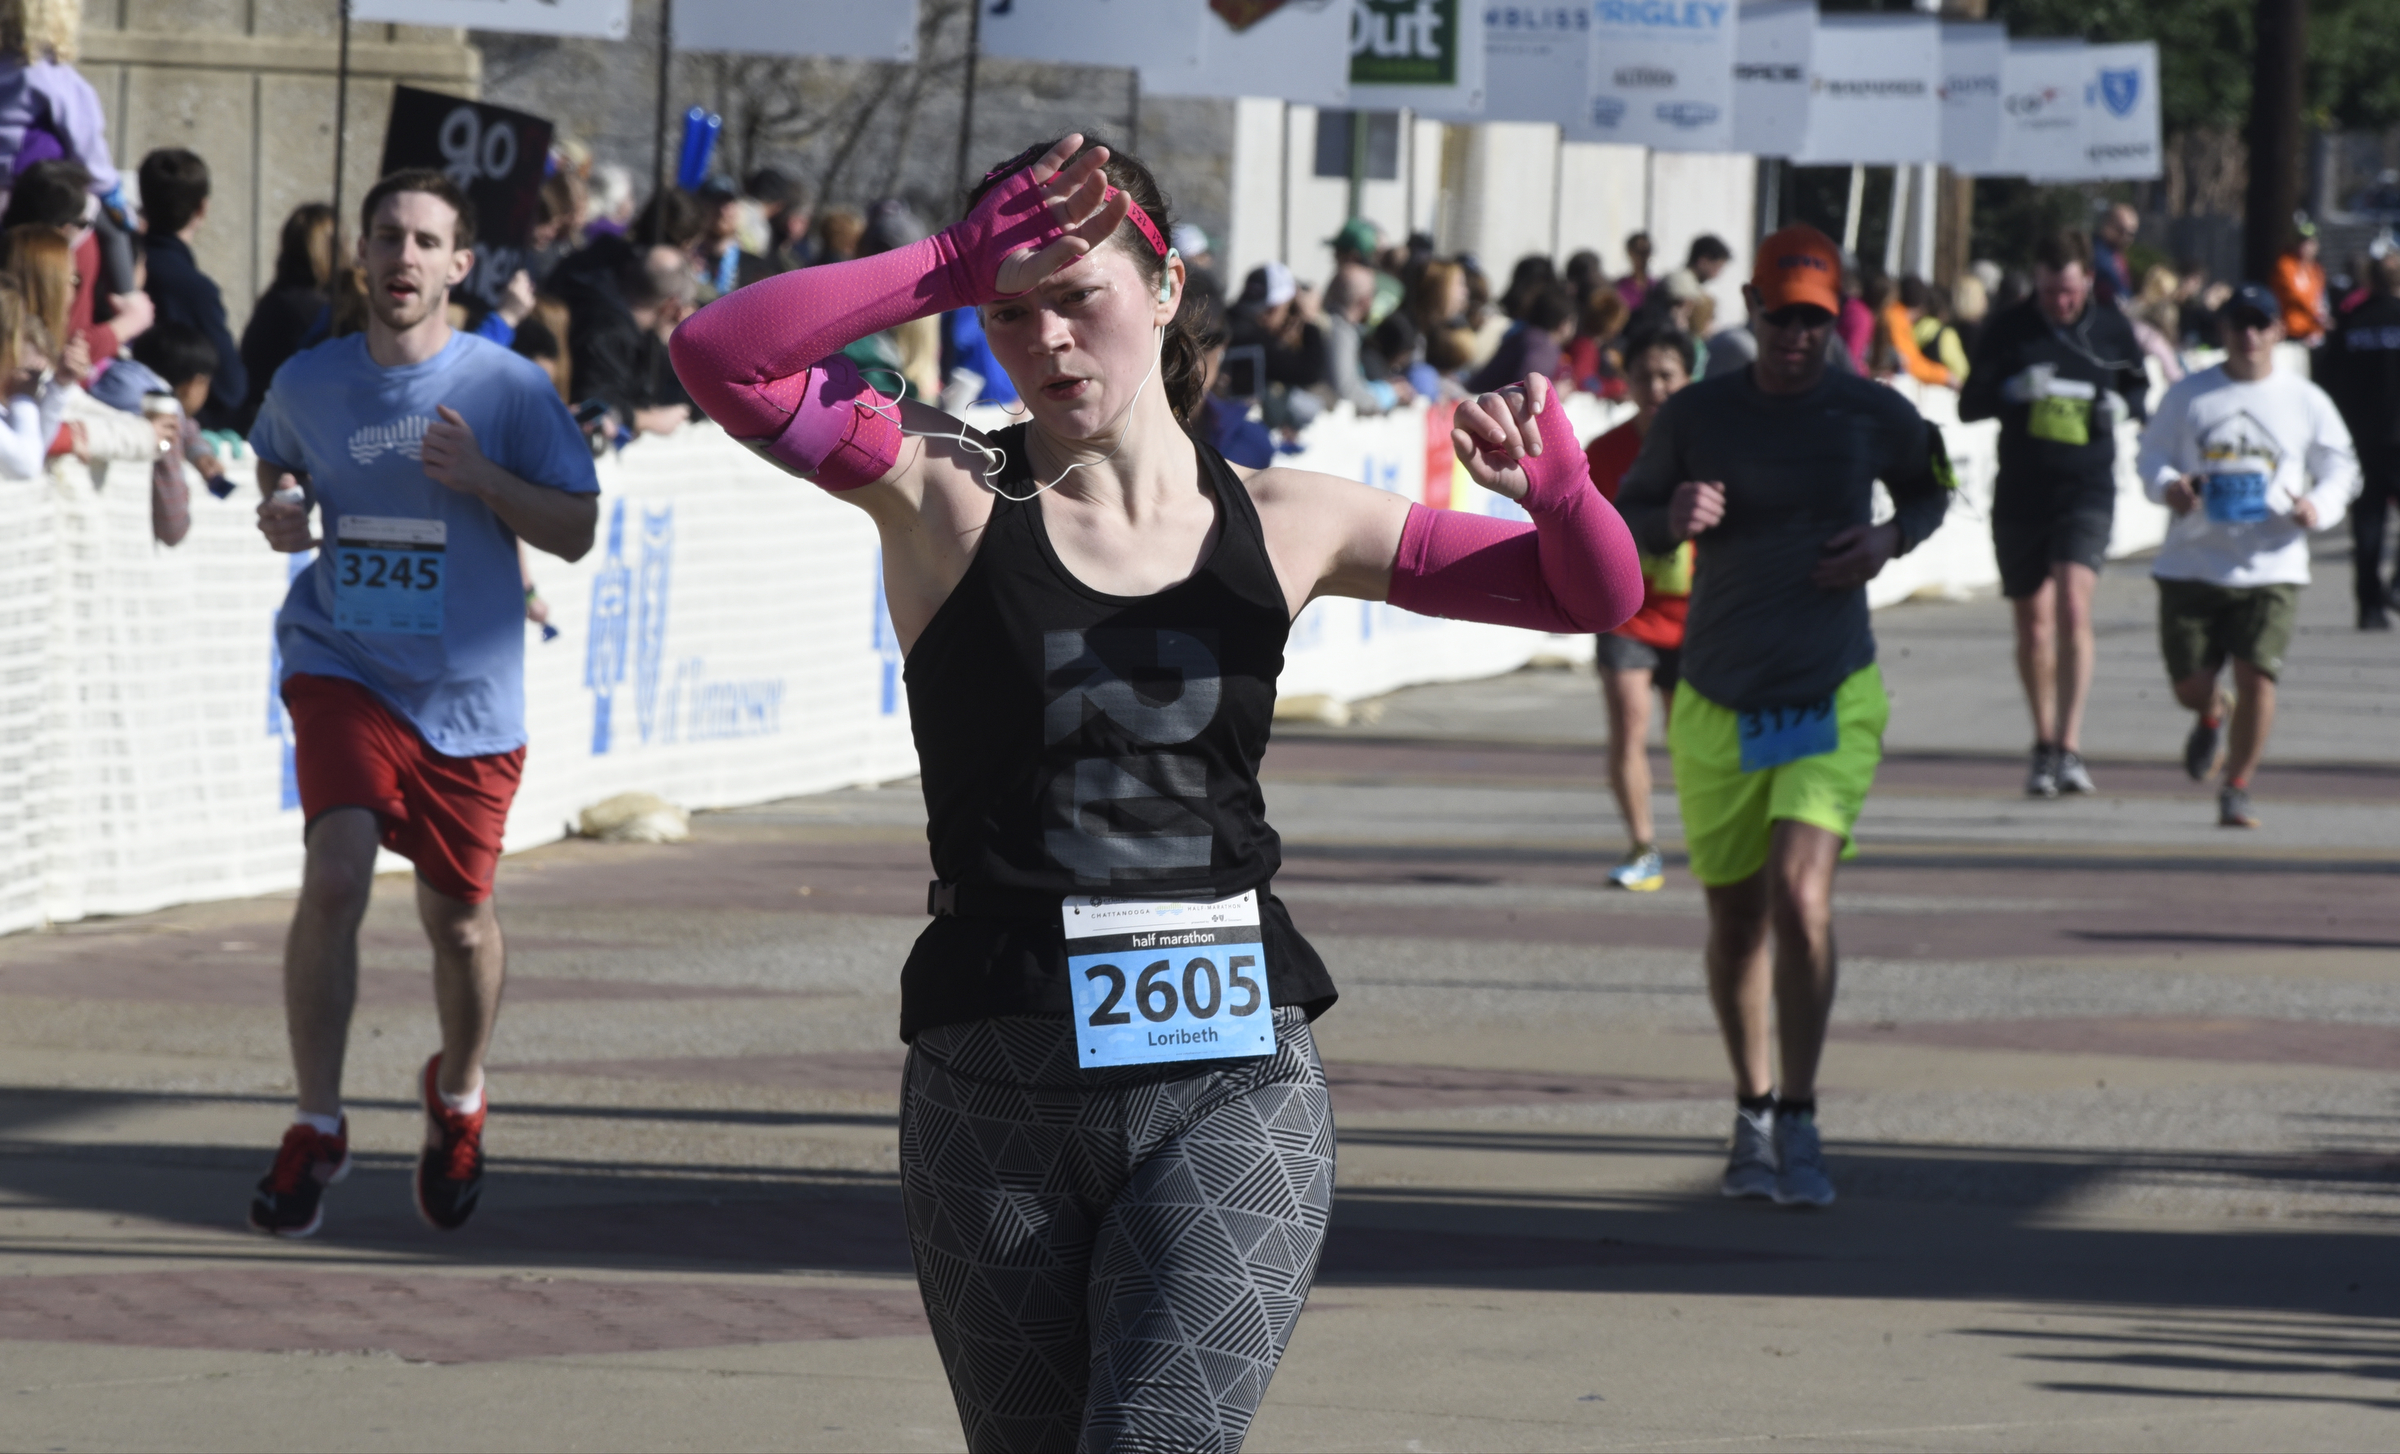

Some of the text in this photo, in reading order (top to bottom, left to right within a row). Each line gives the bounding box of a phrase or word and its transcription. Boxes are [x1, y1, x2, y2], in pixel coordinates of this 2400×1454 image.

[1595, 0, 1728, 28] RIGLEY
[341, 552, 439, 591] 3245
[1091, 909, 1150, 919] CHATTANOOGA
[1132, 931, 1215, 948] half marathon
[1084, 955, 1262, 1027] 2605
[1147, 1026, 1219, 1047] Loribeth
